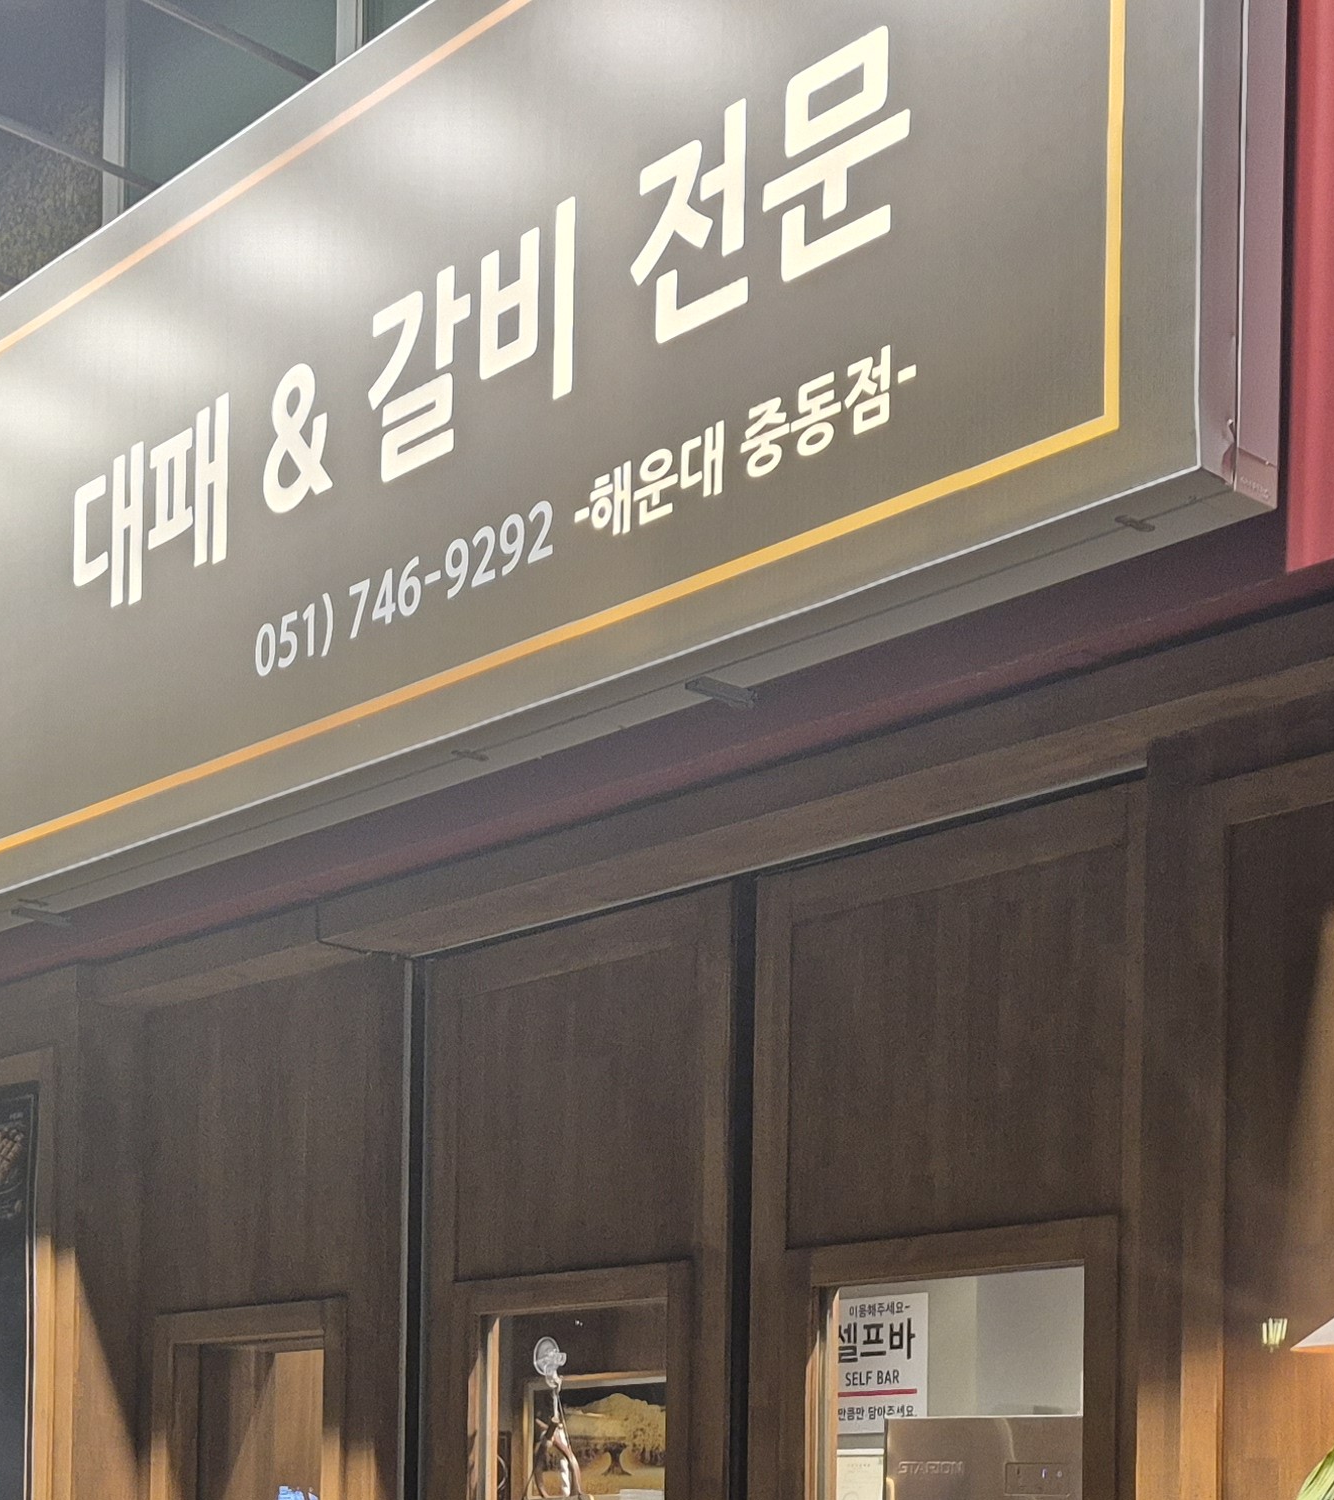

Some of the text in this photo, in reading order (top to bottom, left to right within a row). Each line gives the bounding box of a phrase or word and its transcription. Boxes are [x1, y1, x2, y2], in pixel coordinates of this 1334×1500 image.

[73, 25, 910, 607] 대패 & 갈비 전문
[574, 346, 917, 536] -해운대 중동점-
[255, 500, 555, 677] 051) 746-9292
[838, 1318, 916, 1363] 셀프바
[845, 1369, 899, 1386] SELF BAR
[898, 1461, 964, 1475] STARION
